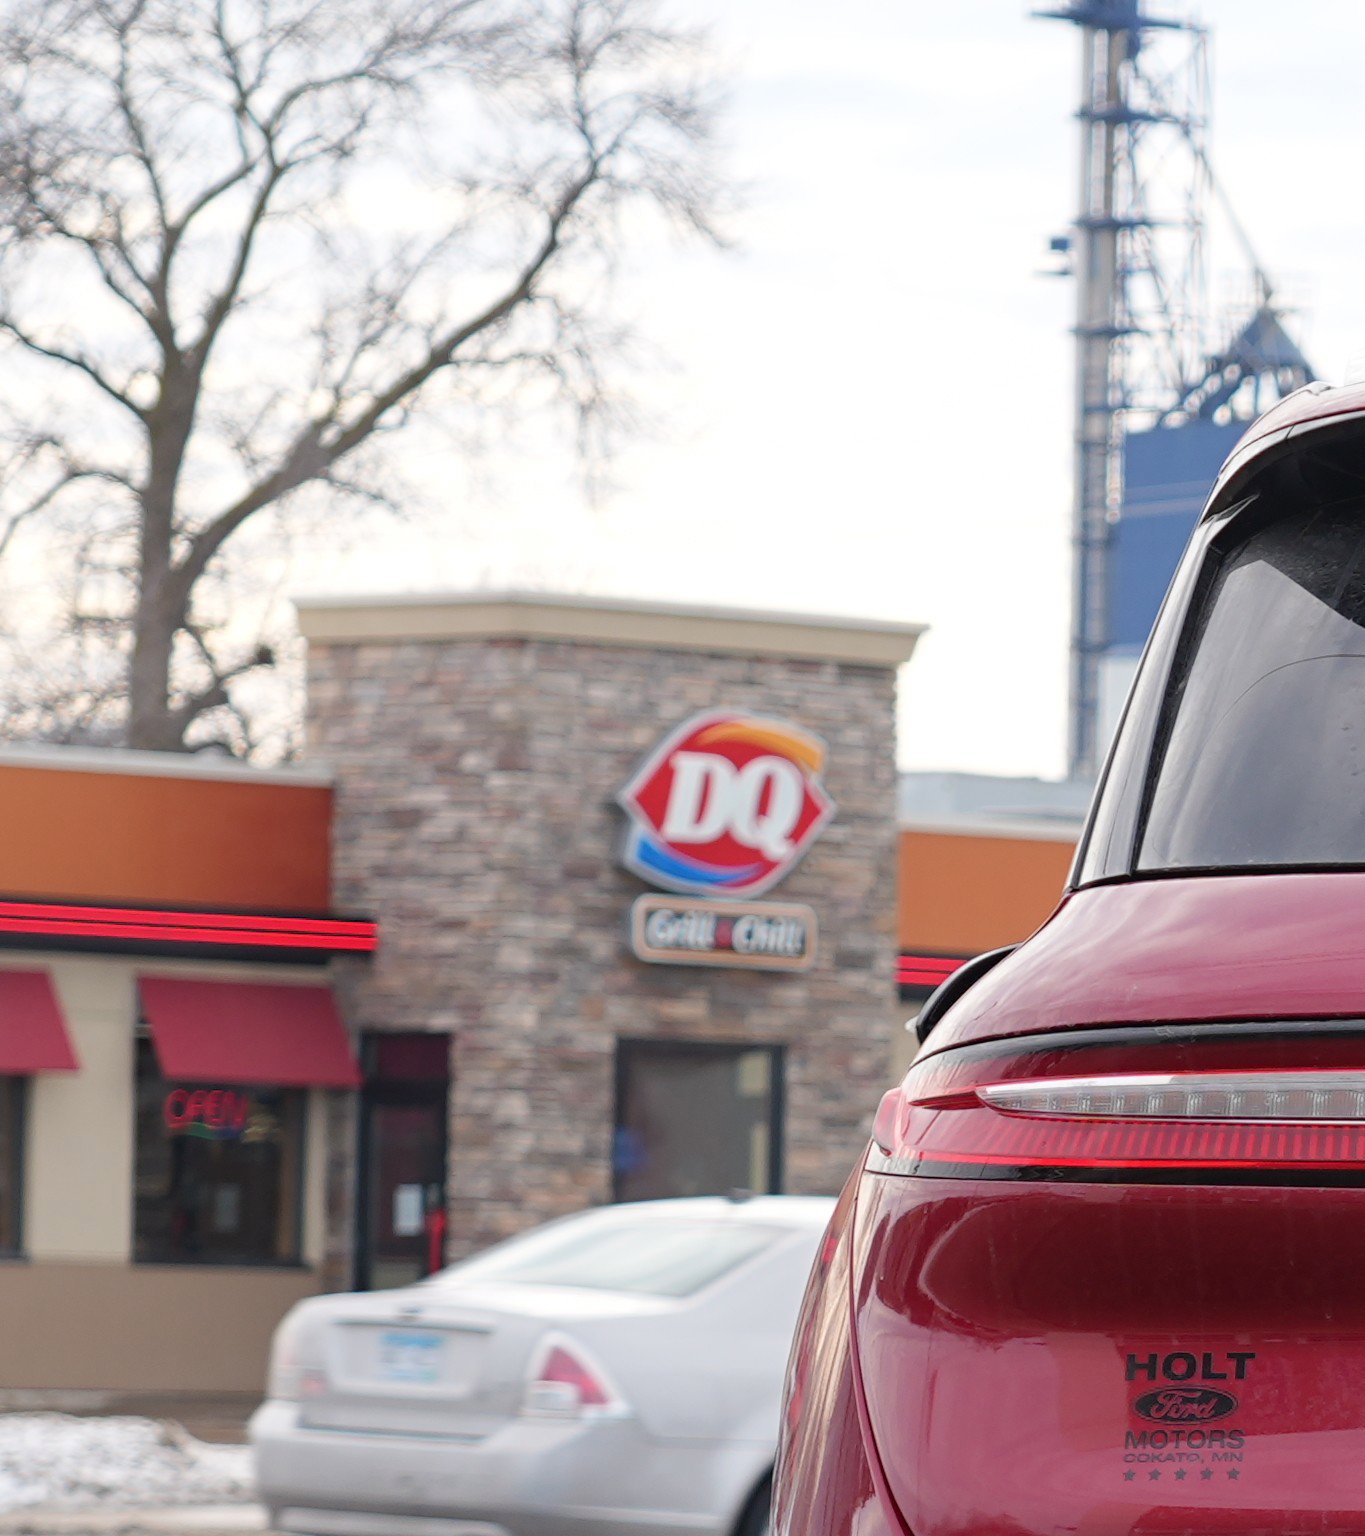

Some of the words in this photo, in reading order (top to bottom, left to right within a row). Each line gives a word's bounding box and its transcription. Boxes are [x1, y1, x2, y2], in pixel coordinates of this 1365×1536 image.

[661, 749, 805, 862] DQ
[647, 908, 715, 950] Grill
[732, 914, 805, 957] Chill
[165, 1088, 248, 1130] OPEN
[1125, 1352, 1256, 1381] HOLT
[1150, 1390, 1219, 1419] Ford
[1124, 1429, 1246, 1450] MOTORS
[1123, 1452, 1204, 1463] COKATO,
[1212, 1452, 1243, 1462] MN
